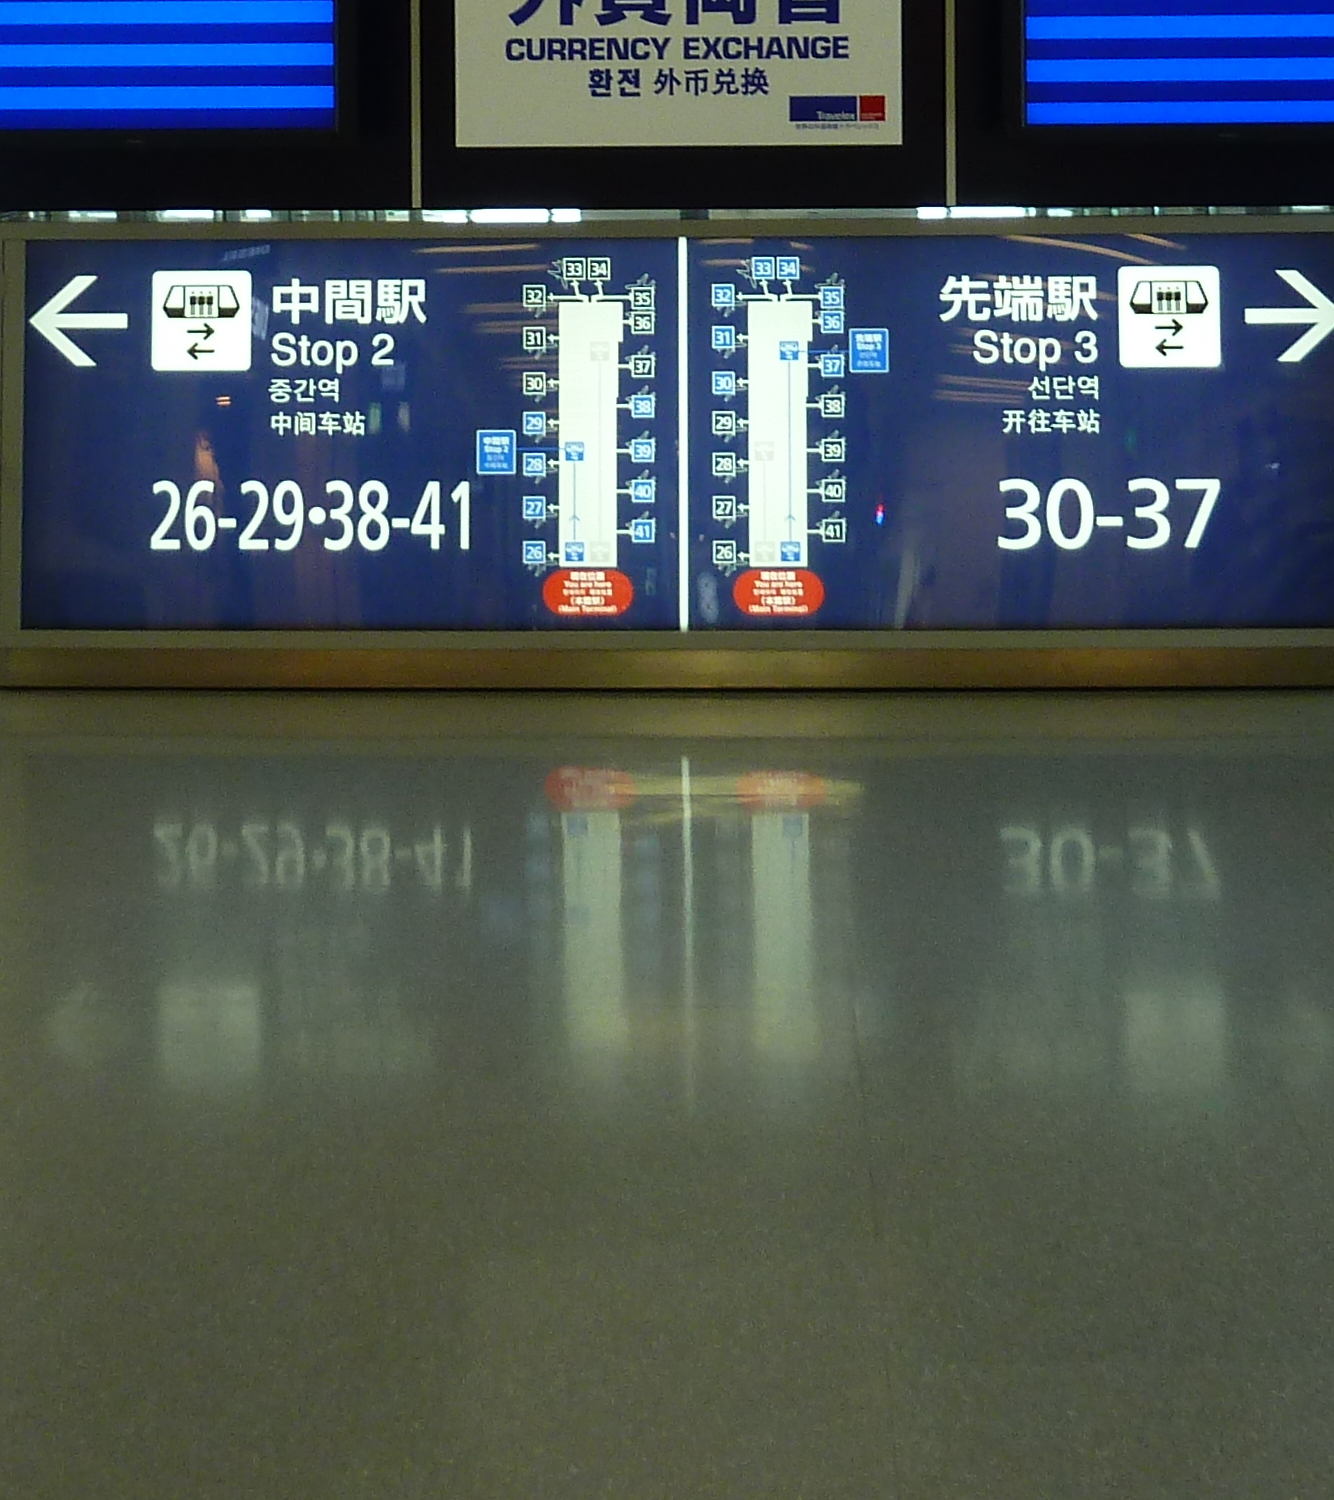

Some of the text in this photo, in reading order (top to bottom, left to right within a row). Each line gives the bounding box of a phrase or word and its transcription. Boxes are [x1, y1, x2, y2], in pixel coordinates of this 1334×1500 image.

[506, 35, 849, 62] CURRENCY EXCHANGE
[588, 67, 770, 97] 환전 外币兑换
[567, 264, 582, 276] 33
[590, 264, 607, 276] 34
[755, 263, 771, 275] 33
[780, 263, 796, 275] 34
[271, 278, 427, 325] 中間駅
[526, 290, 542, 303] 32
[635, 293, 650, 305] 35
[716, 290, 732, 302] 32
[824, 292, 840, 304] 35
[939, 274, 1098, 323] 先端駅
[635, 317, 650, 329] 36
[824, 316, 840, 329] 36
[526, 333, 542, 345] 31
[716, 332, 732, 344] 31
[270, 332, 395, 373] Stop 2
[972, 330, 1099, 370] Stop 3
[635, 361, 650, 373] 37
[824, 360, 840, 372] 37
[526, 378, 543, 389] 30
[716, 377, 733, 389] 30
[1027, 375, 1100, 401] 선단역
[268, 378, 340, 403] 중간역
[635, 400, 651, 413] 38
[825, 400, 841, 413] 38
[270, 411, 366, 436] 中间车站
[526, 417, 542, 430] 29
[716, 417, 732, 429] 29
[1002, 408, 1101, 434] 开往车站
[635, 445, 650, 457] 39
[825, 444, 841, 457] 39
[527, 458, 543, 470] 28
[716, 458, 733, 470] 28
[635, 485, 651, 497] 40
[825, 485, 842, 497] 40
[527, 502, 542, 514] 27
[717, 502, 732, 514] 27
[997, 477, 1222, 551] 30-37
[635, 525, 650, 538] 41
[825, 525, 840, 537] 41
[527, 547, 542, 559] 26
[717, 546, 733, 559] 26
